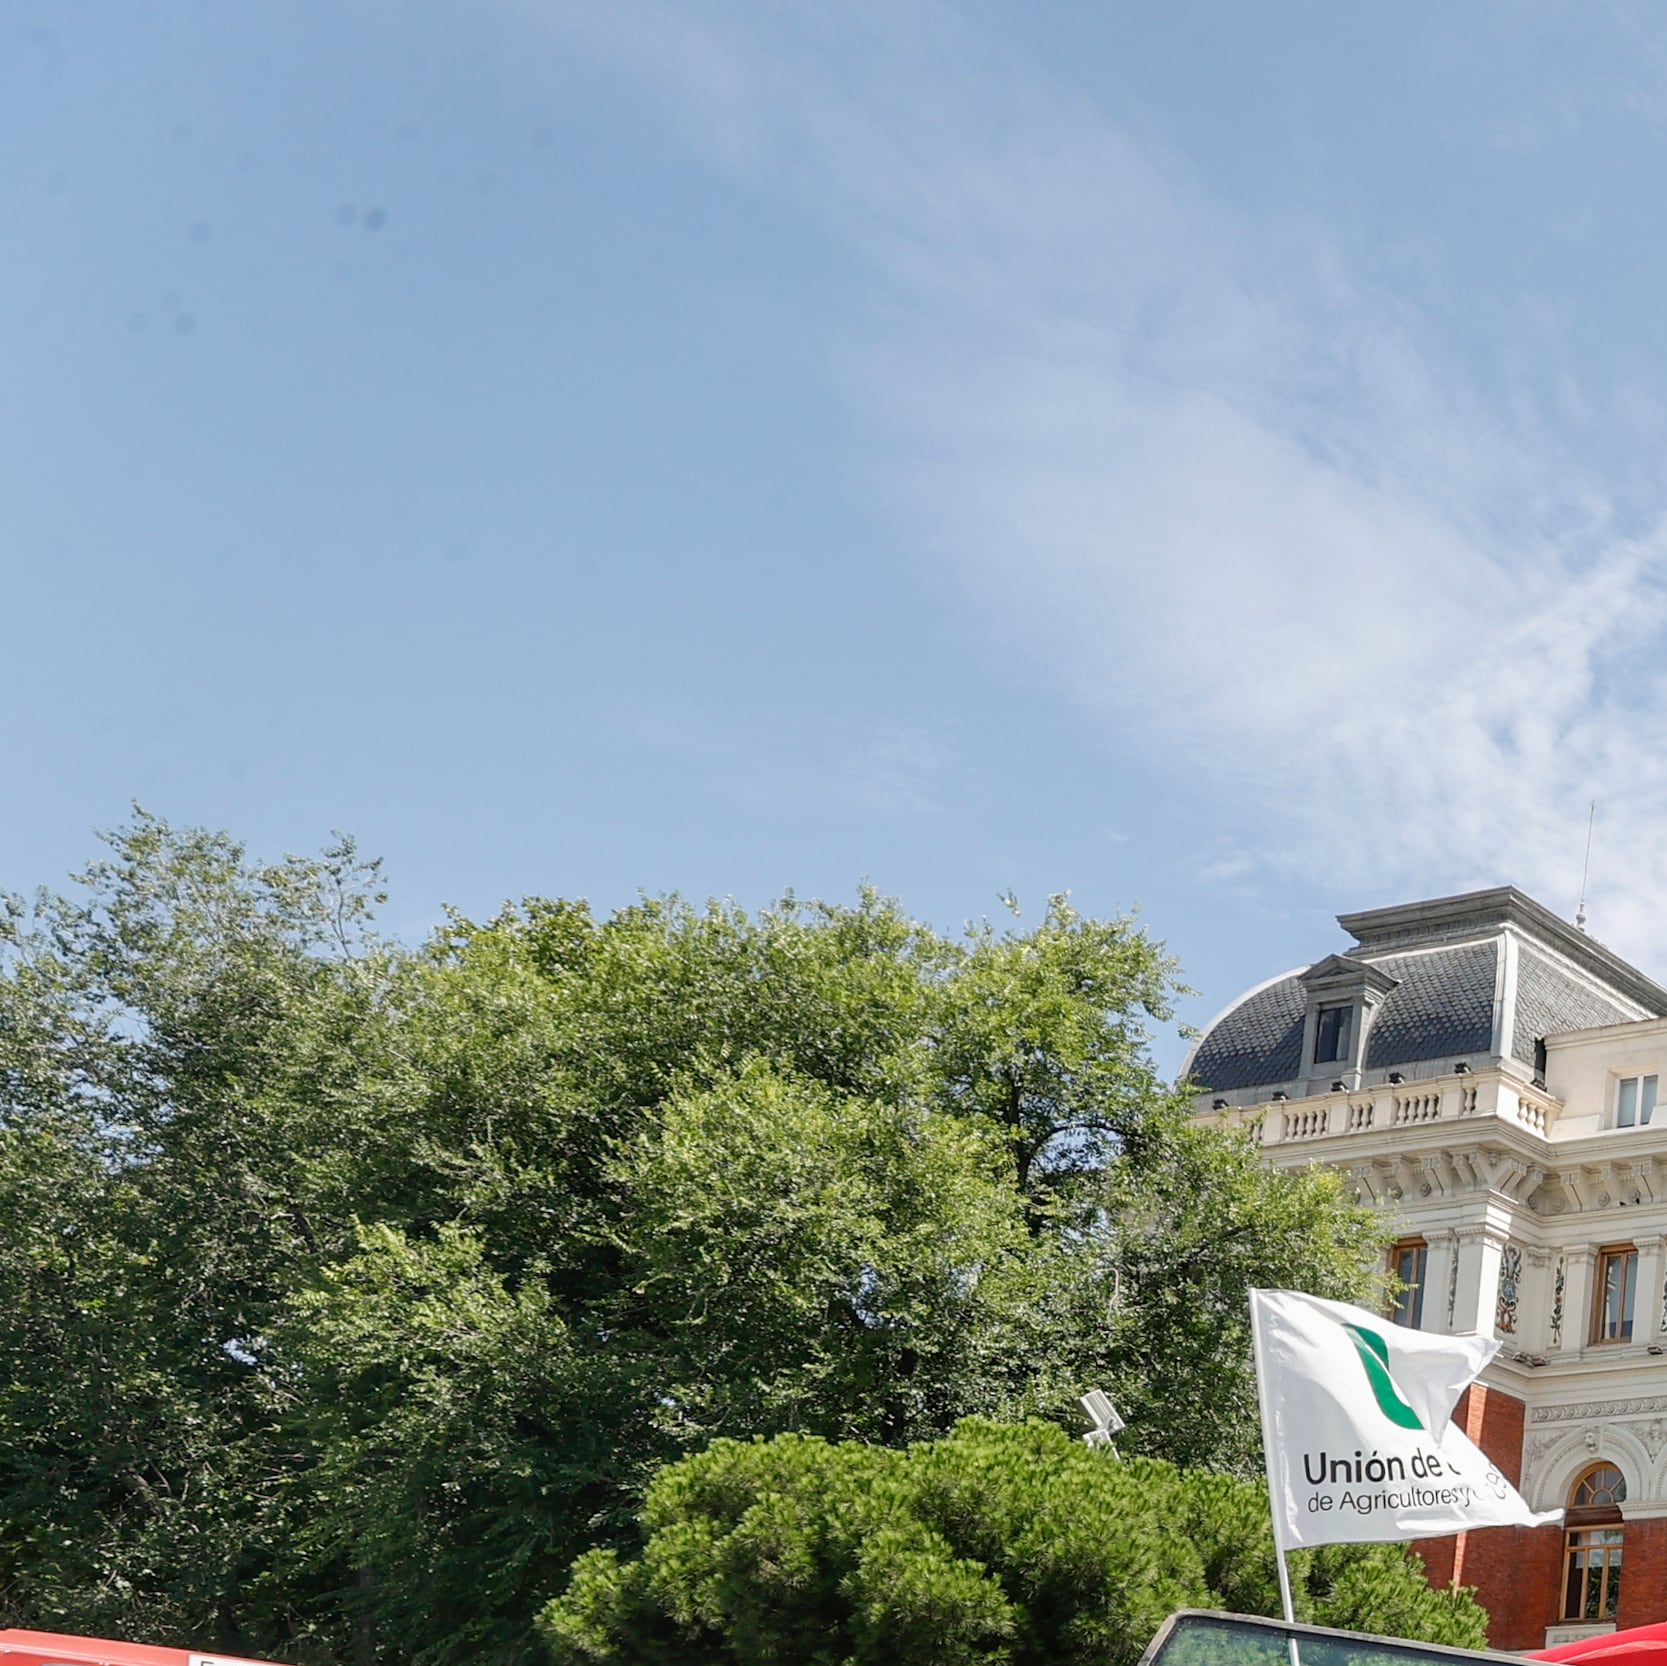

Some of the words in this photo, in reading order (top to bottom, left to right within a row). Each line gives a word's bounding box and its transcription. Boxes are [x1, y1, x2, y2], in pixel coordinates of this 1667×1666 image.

[1303, 1449, 1405, 1486] Unión
[1411, 1447, 1443, 1479] de
[1307, 1491, 1333, 1513] de
